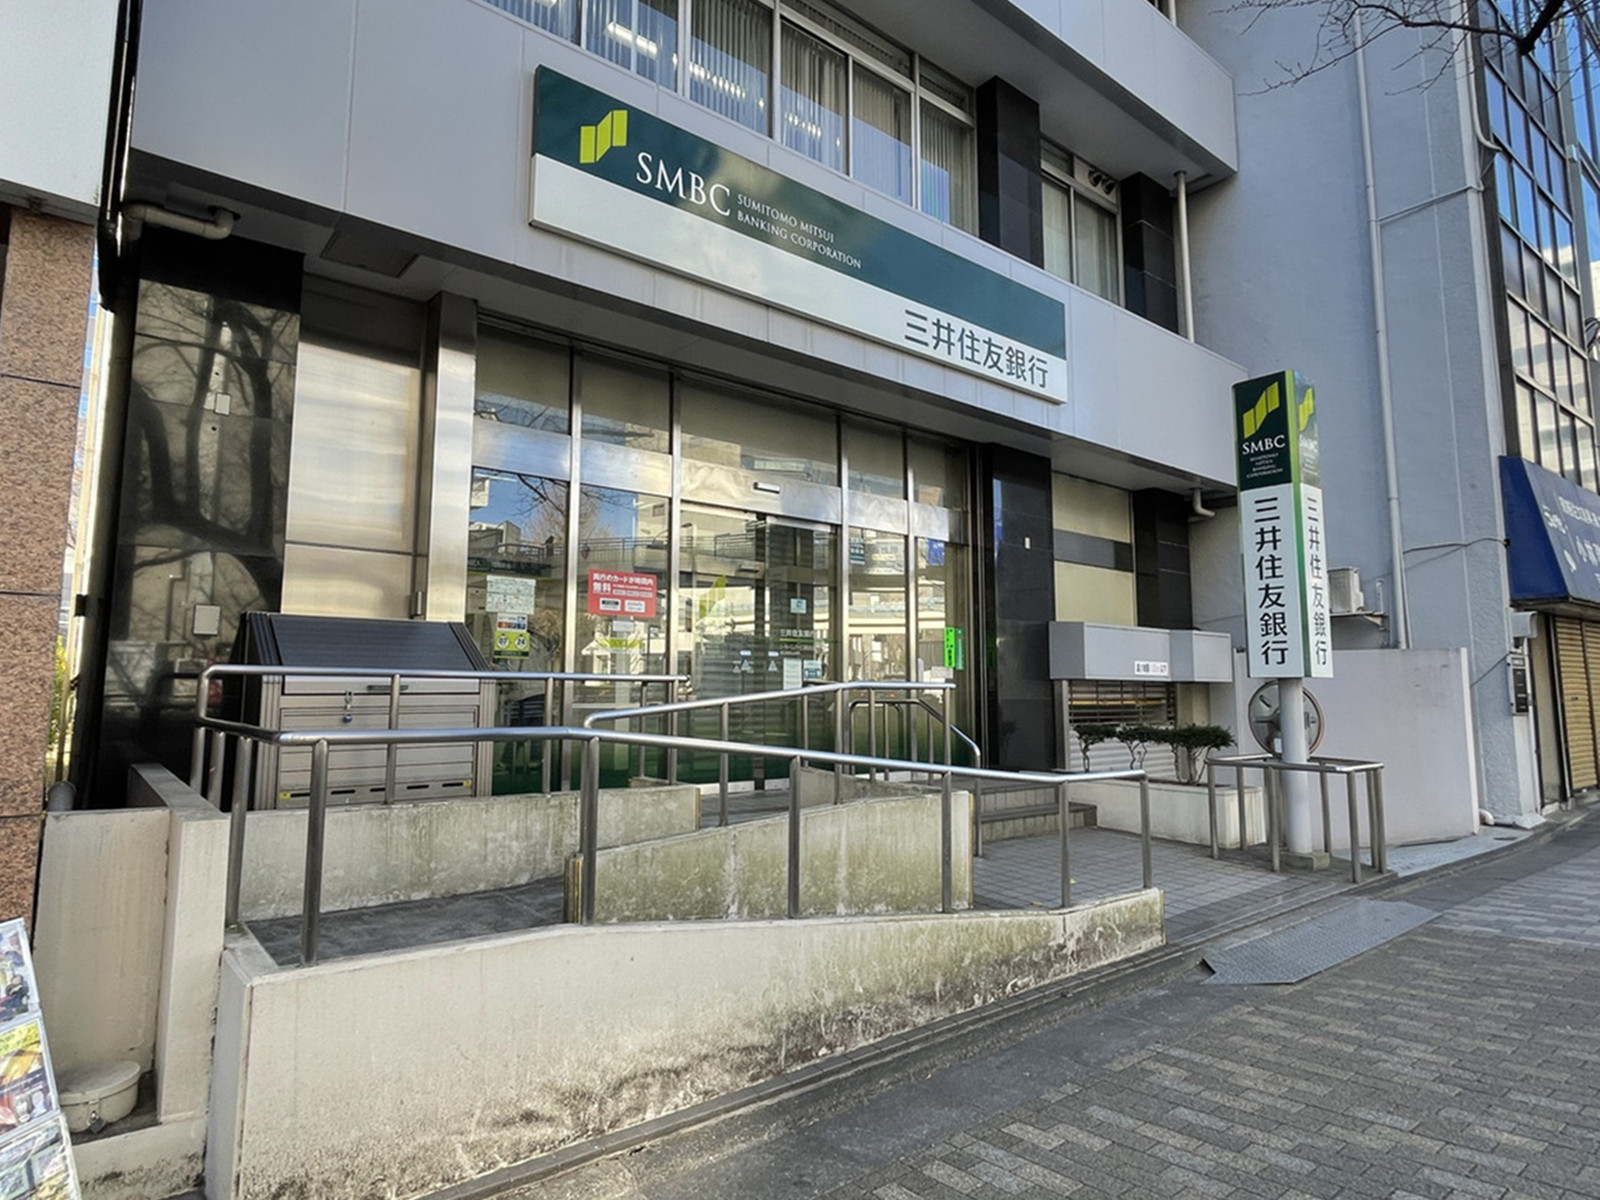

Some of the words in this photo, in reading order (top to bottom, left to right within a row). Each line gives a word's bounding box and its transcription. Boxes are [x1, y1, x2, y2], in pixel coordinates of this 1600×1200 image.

[636, 152, 731, 216] SMBC
[737, 194, 798, 227] SUMITOMO
[800, 221, 834, 243] MITSUI
[737, 211, 788, 239] BANKING
[790, 233, 862, 269] CORPORATION
[904, 309, 1049, 389] 三井住友銀行
[1242, 434, 1286, 455] SMBC
[1254, 497, 1289, 666] 三井住友銀行
[1306, 496, 1327, 666] 三井住友銀行
